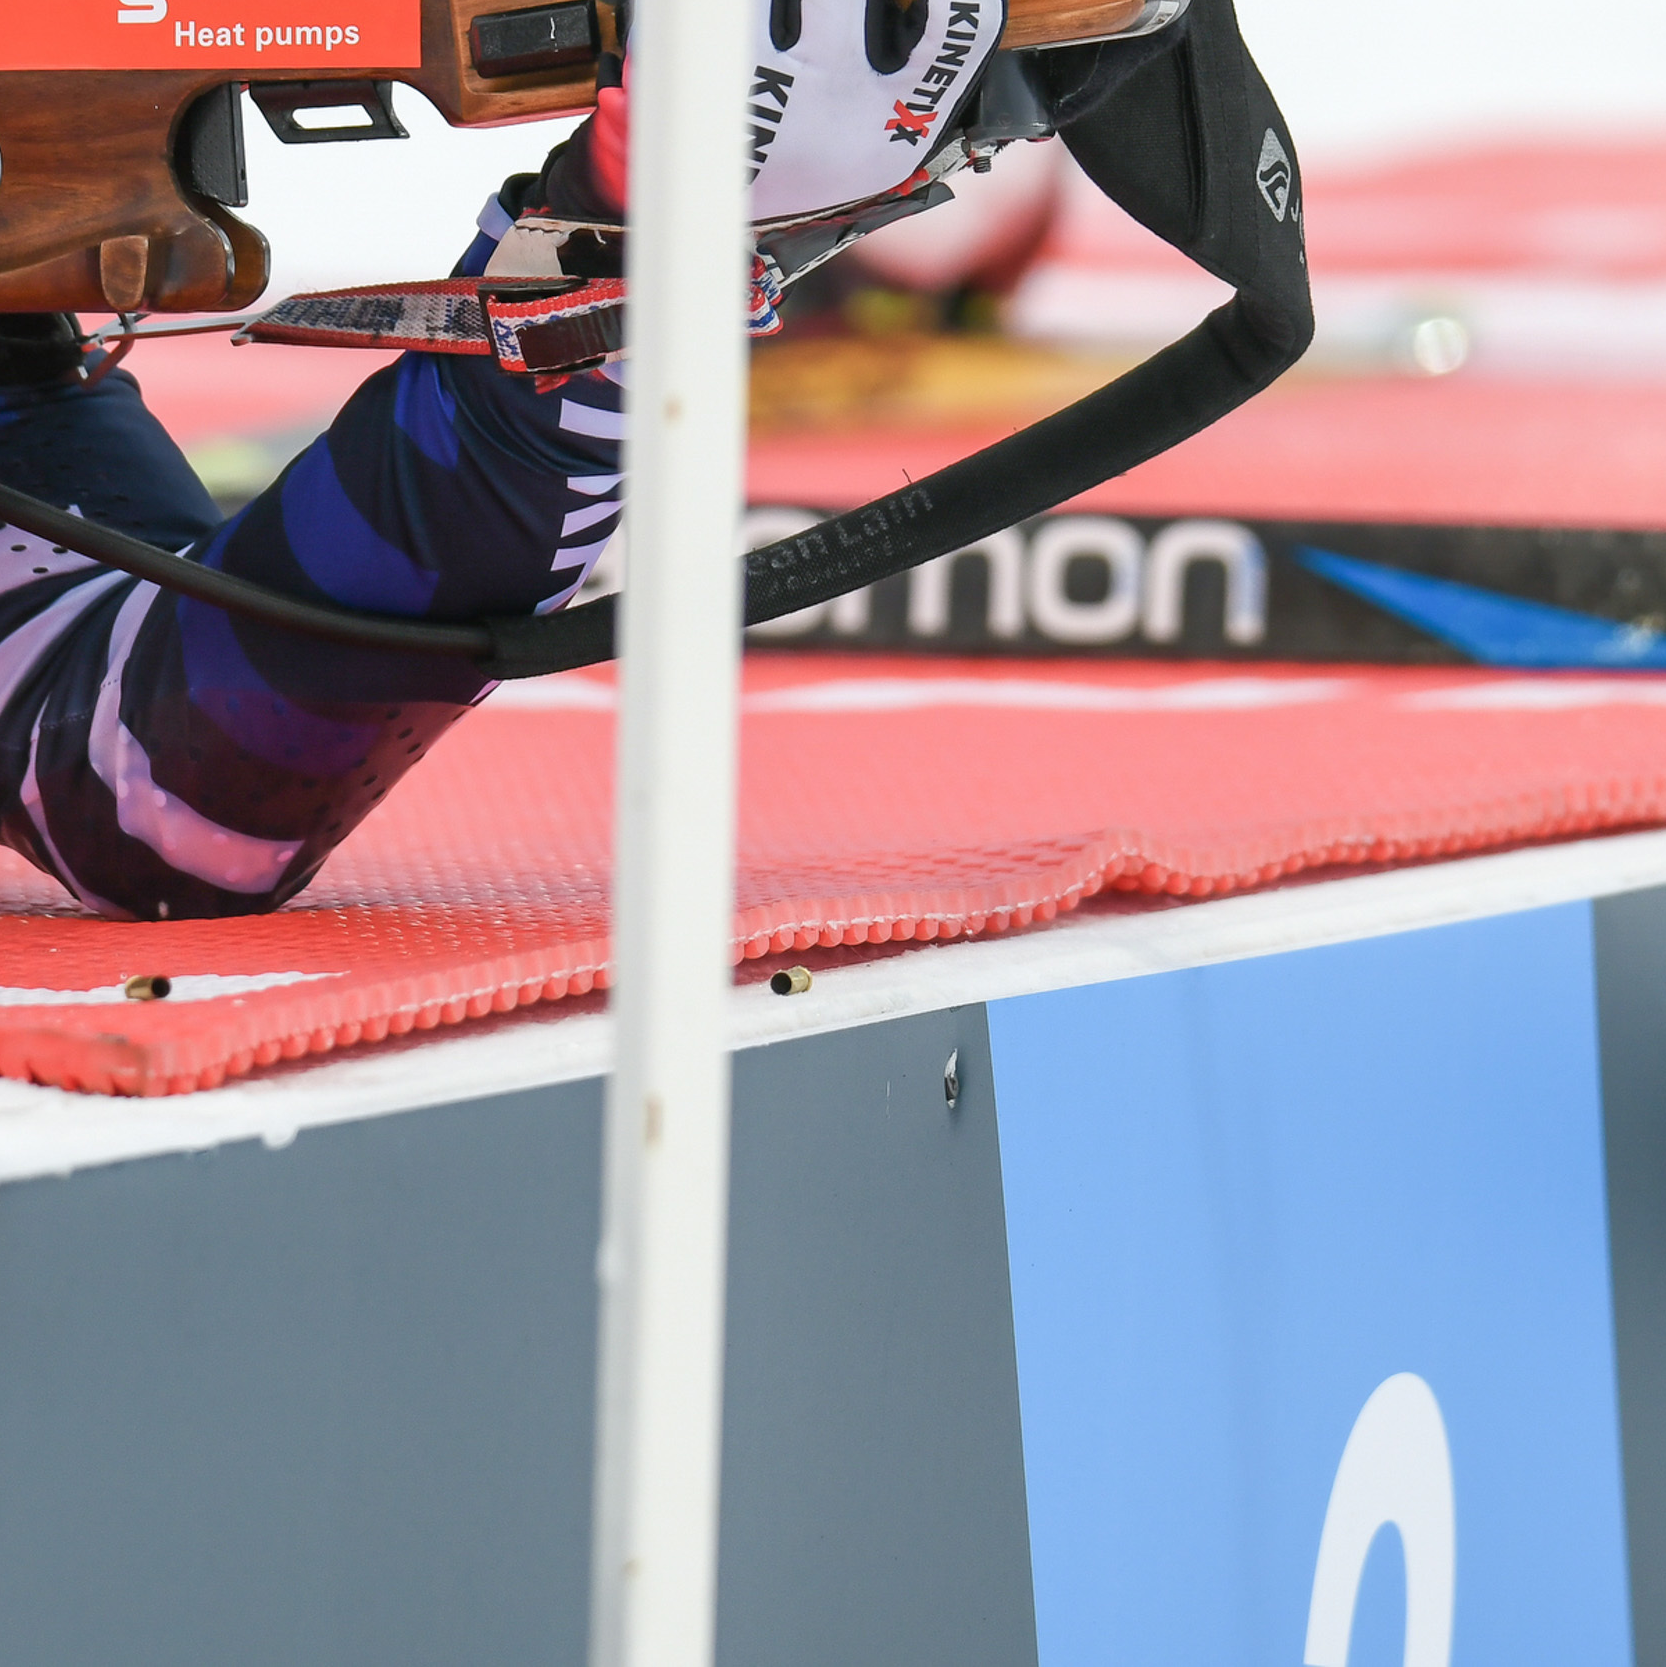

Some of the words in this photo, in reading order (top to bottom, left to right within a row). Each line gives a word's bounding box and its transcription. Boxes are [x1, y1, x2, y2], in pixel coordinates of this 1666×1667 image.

[174, 22, 245, 47] Heat
[255, 22, 360, 52] pumps
[884, 1, 981, 147] KINETIXX
